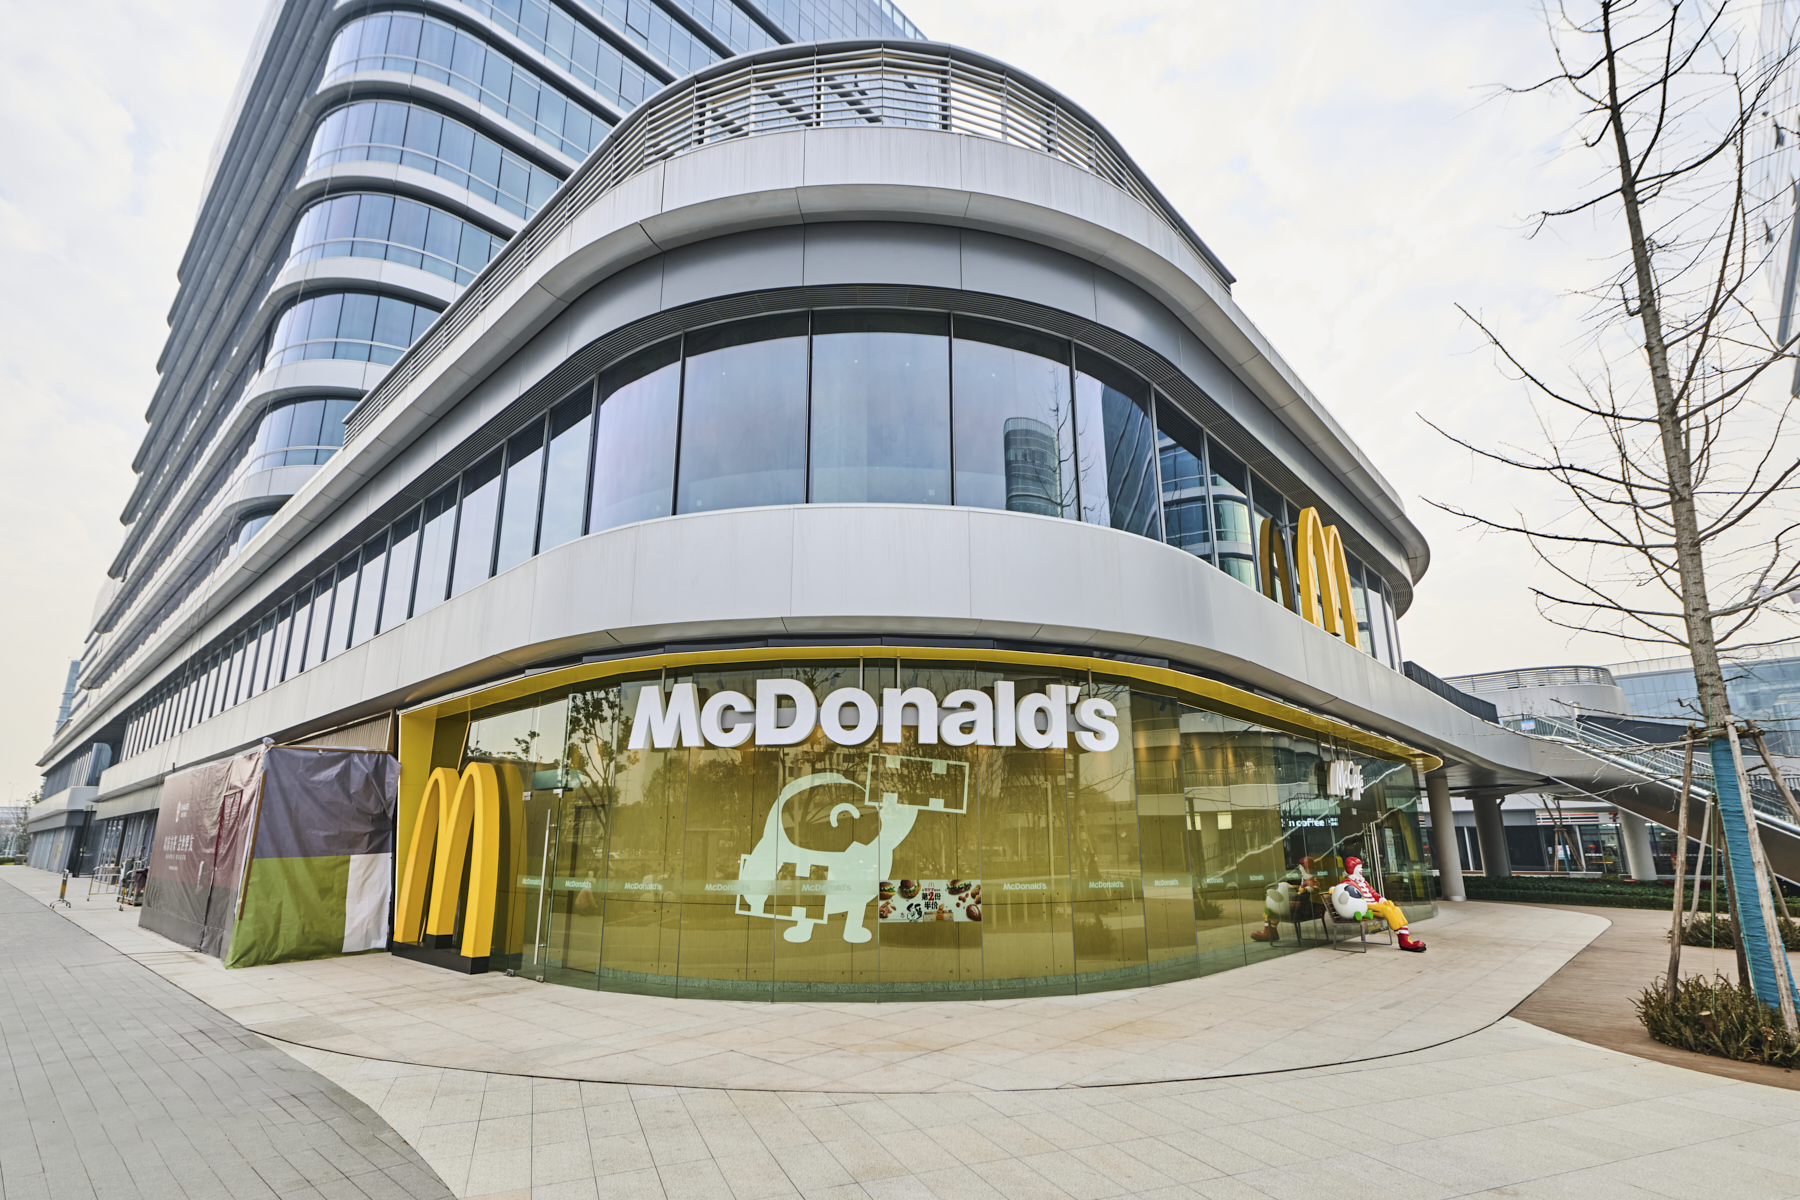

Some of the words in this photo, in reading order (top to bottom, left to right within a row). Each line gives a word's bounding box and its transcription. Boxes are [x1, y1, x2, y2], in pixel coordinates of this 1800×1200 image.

[627, 678, 1120, 753] McDonald's
[1296, 817, 1325, 828] coffee
[565, 880, 592, 889] McDonald's
[624, 882, 662, 891] McDonald's
[704, 883, 751, 892] McDonad's
[1003, 882, 1047, 891] McDonald's
[1089, 881, 1125, 889] McDonald's
